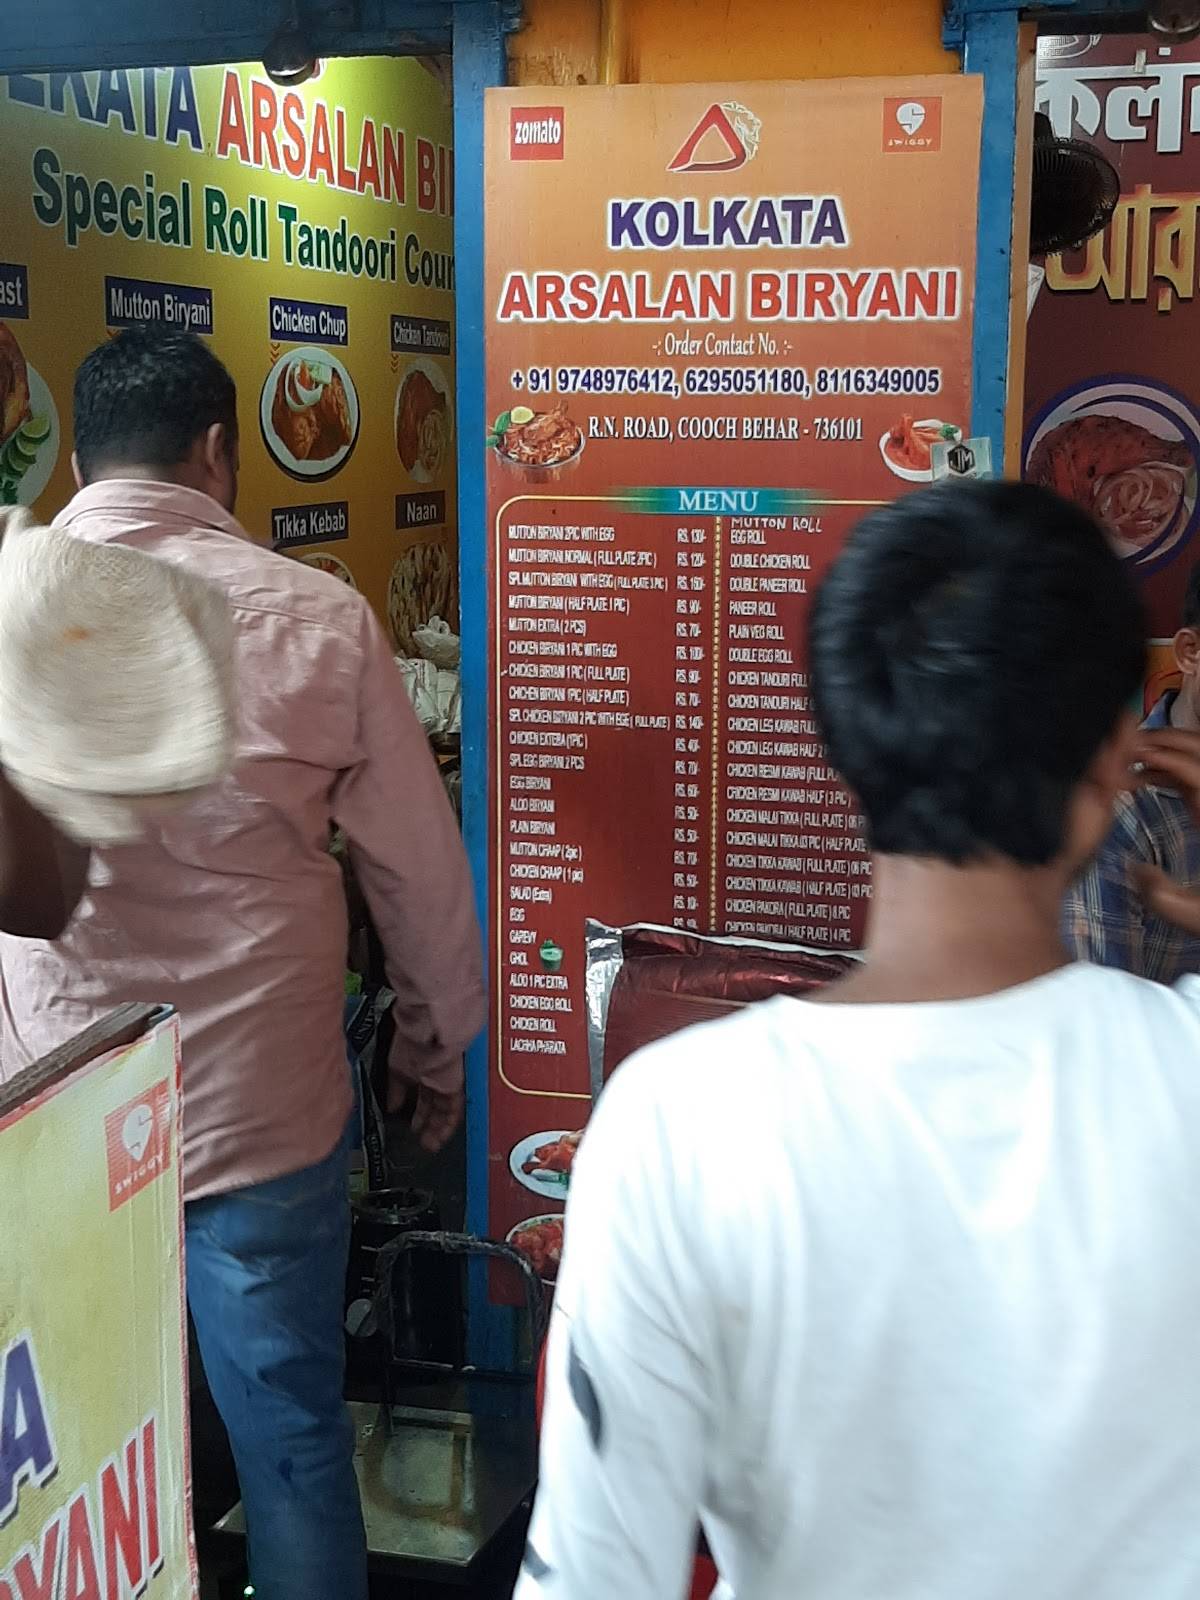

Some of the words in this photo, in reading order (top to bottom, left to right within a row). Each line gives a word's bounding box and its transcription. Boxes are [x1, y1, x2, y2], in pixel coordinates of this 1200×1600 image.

[217, 69, 406, 206] ARSALAN
[417, 137, 453, 217] BI
[514, 118, 561, 145] zomato
[32, 148, 192, 247] Special
[204, 187, 268, 260] Roll
[277, 203, 397, 282] Tandoori
[608, 197, 849, 248] KOLKATA
[111, 287, 159, 319] Mutton
[164, 293, 211, 331] Biryani
[499, 271, 733, 321] ARSALAN
[749, 270, 959, 320] BIRYANI
[272, 304, 317, 335] Chicken
[319, 310, 347, 340] Chup
[664, 331, 701, 356] Order
[705, 332, 754, 356] Contact
[757, 334, 780, 356] No.
[529, 369, 551, 392] 91
[558, 368, 680, 397] 9748976412,
[685, 369, 812, 397] 6295051180,
[817, 368, 941, 393] 8116349005
[588, 416, 619, 438] R.N.
[623, 416, 673, 443] ROAD,
[678, 416, 737, 439] COOCH
[743, 416, 799, 440] BEHAR
[814, 417, 864, 440] 736101
[407, 501, 437, 523] Naan
[679, 490, 758, 512] MENU
[274, 514, 307, 540] Tikka
[310, 508, 346, 535] Kebab
[731, 517, 786, 531] MUTTON
[792, 517, 823, 533] ROLL
